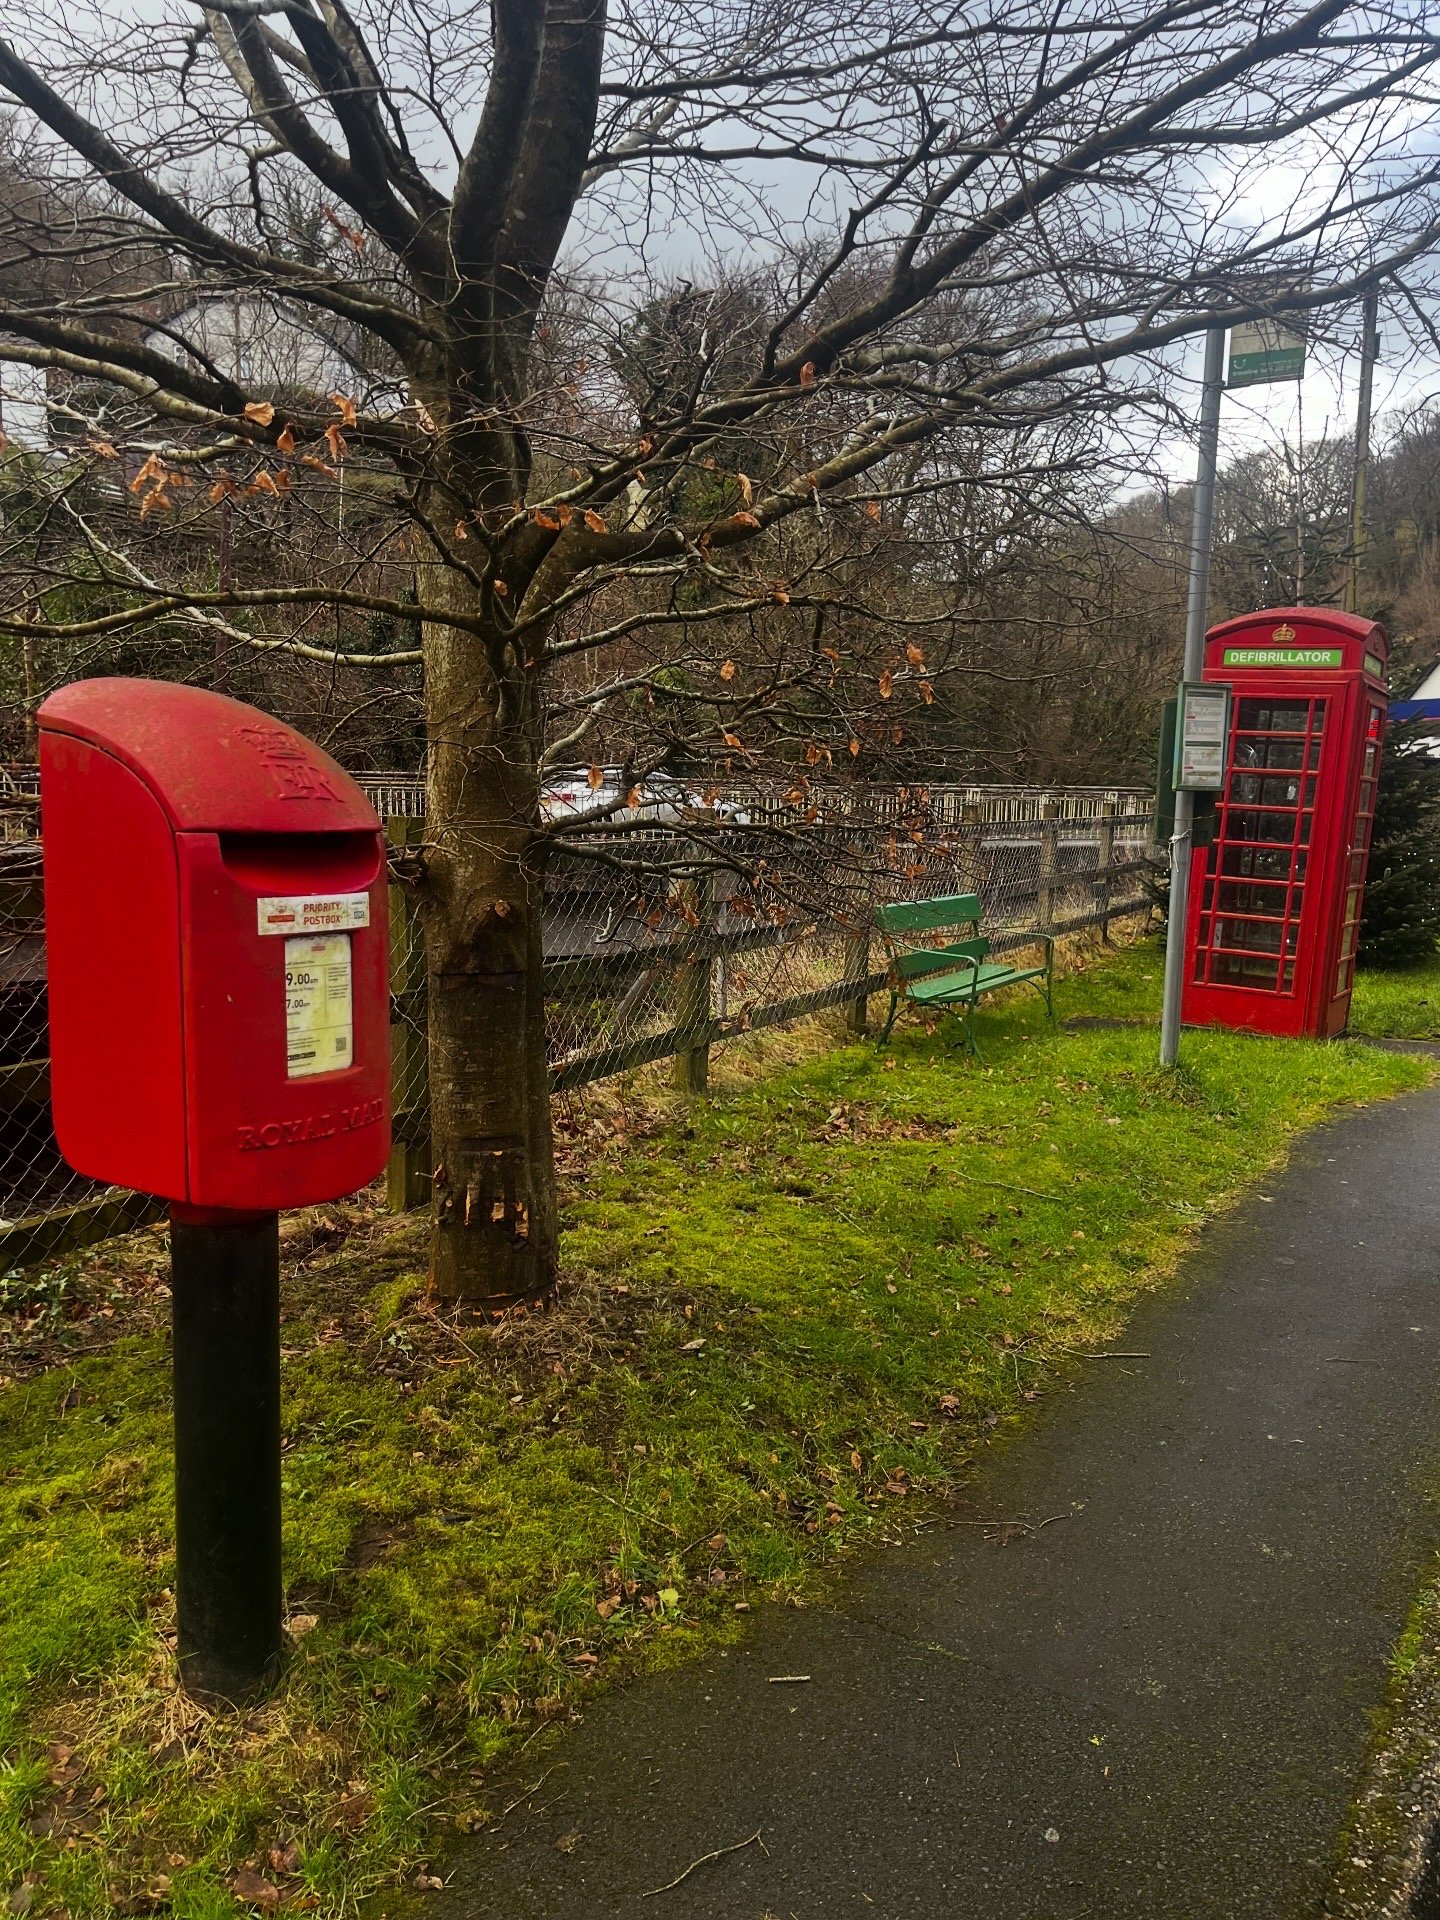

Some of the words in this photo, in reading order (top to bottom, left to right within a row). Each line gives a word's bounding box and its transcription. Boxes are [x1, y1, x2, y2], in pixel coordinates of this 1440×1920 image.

[1230, 651, 1331, 663] DEFIBRILLATOR
[303, 901, 341, 913] PRIORITY
[303, 914, 341, 926] POSTBOX
[237, 1114, 336, 1150] ROYAL
